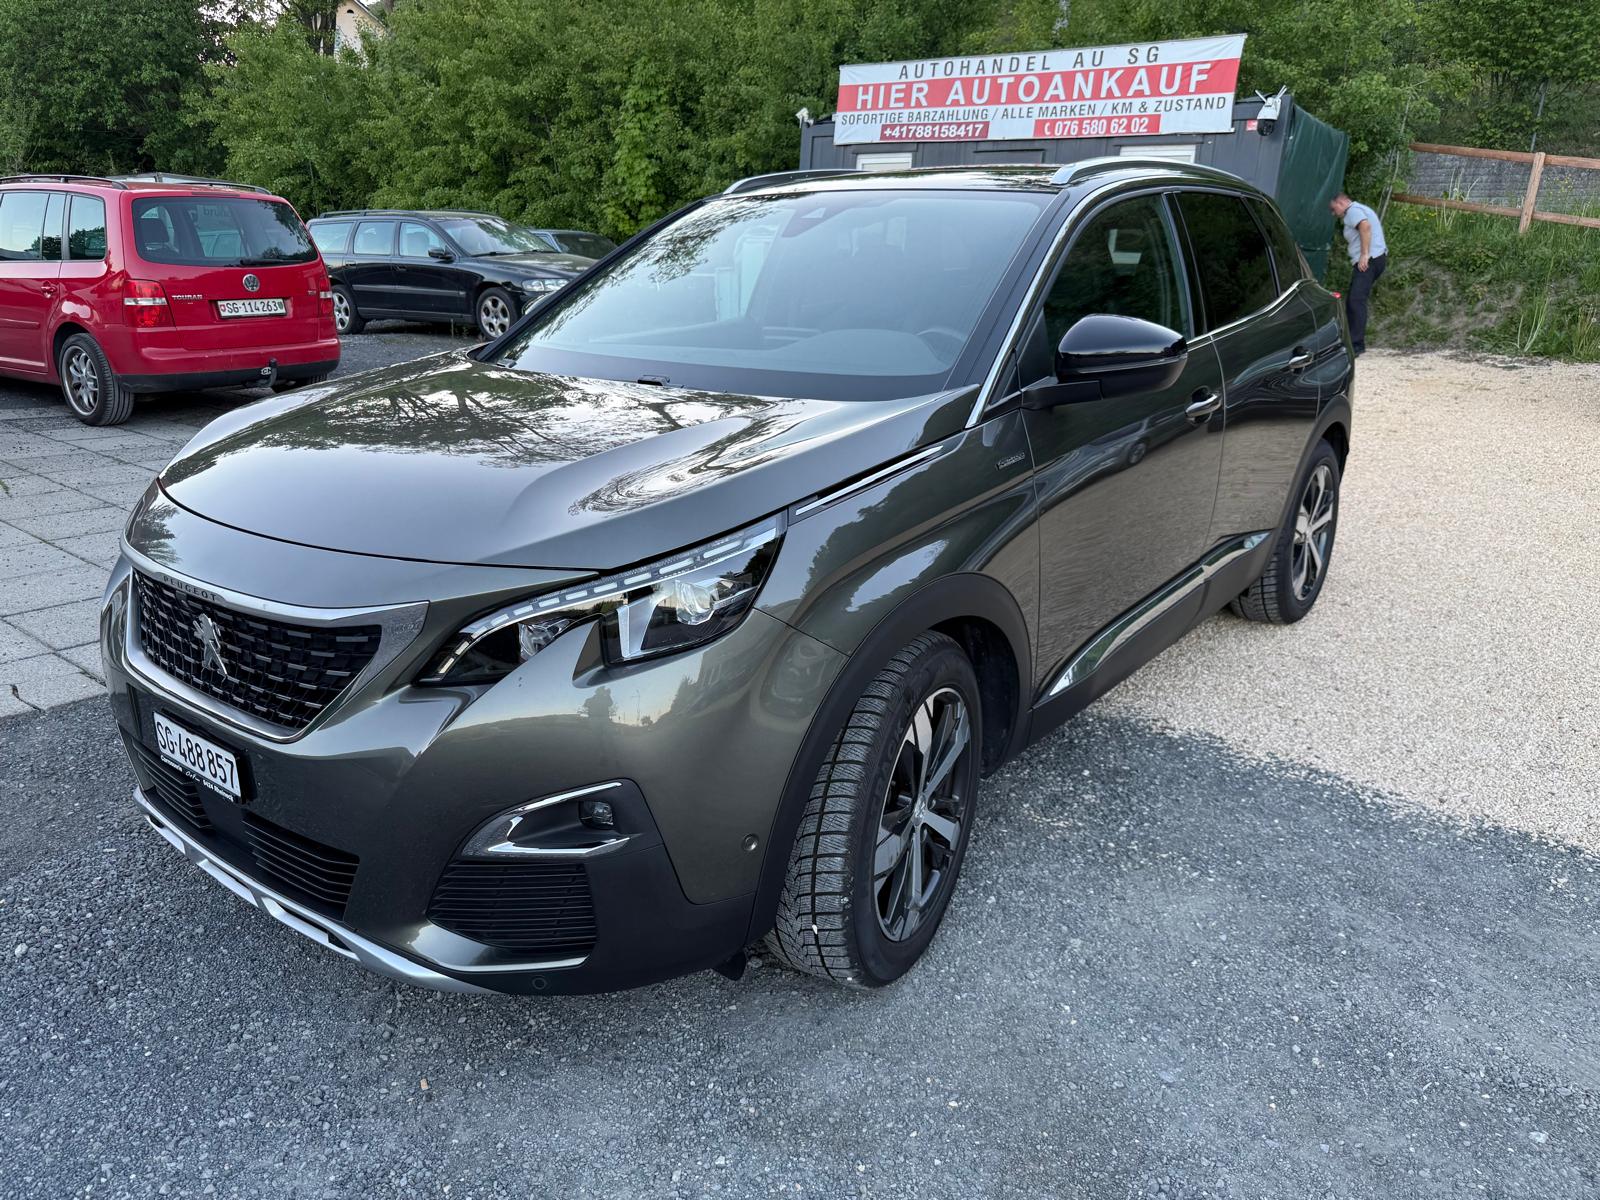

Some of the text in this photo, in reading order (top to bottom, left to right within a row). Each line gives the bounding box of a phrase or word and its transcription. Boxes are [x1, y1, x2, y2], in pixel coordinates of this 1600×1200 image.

[899, 46, 1159, 80] AUTOHANDEL AU SG
[856, 63, 1212, 110] HIER AUTOANKAUF
[841, 96, 1226, 126] SOFORTIGE BARZAHLUNG / ALLE MARKEN / KM & ZUSTAND
[883, 123, 985, 139] +41788158417
[1054, 116, 1149, 136] 076 580 62 02
[163, 575, 217, 601] PEUGEOT
